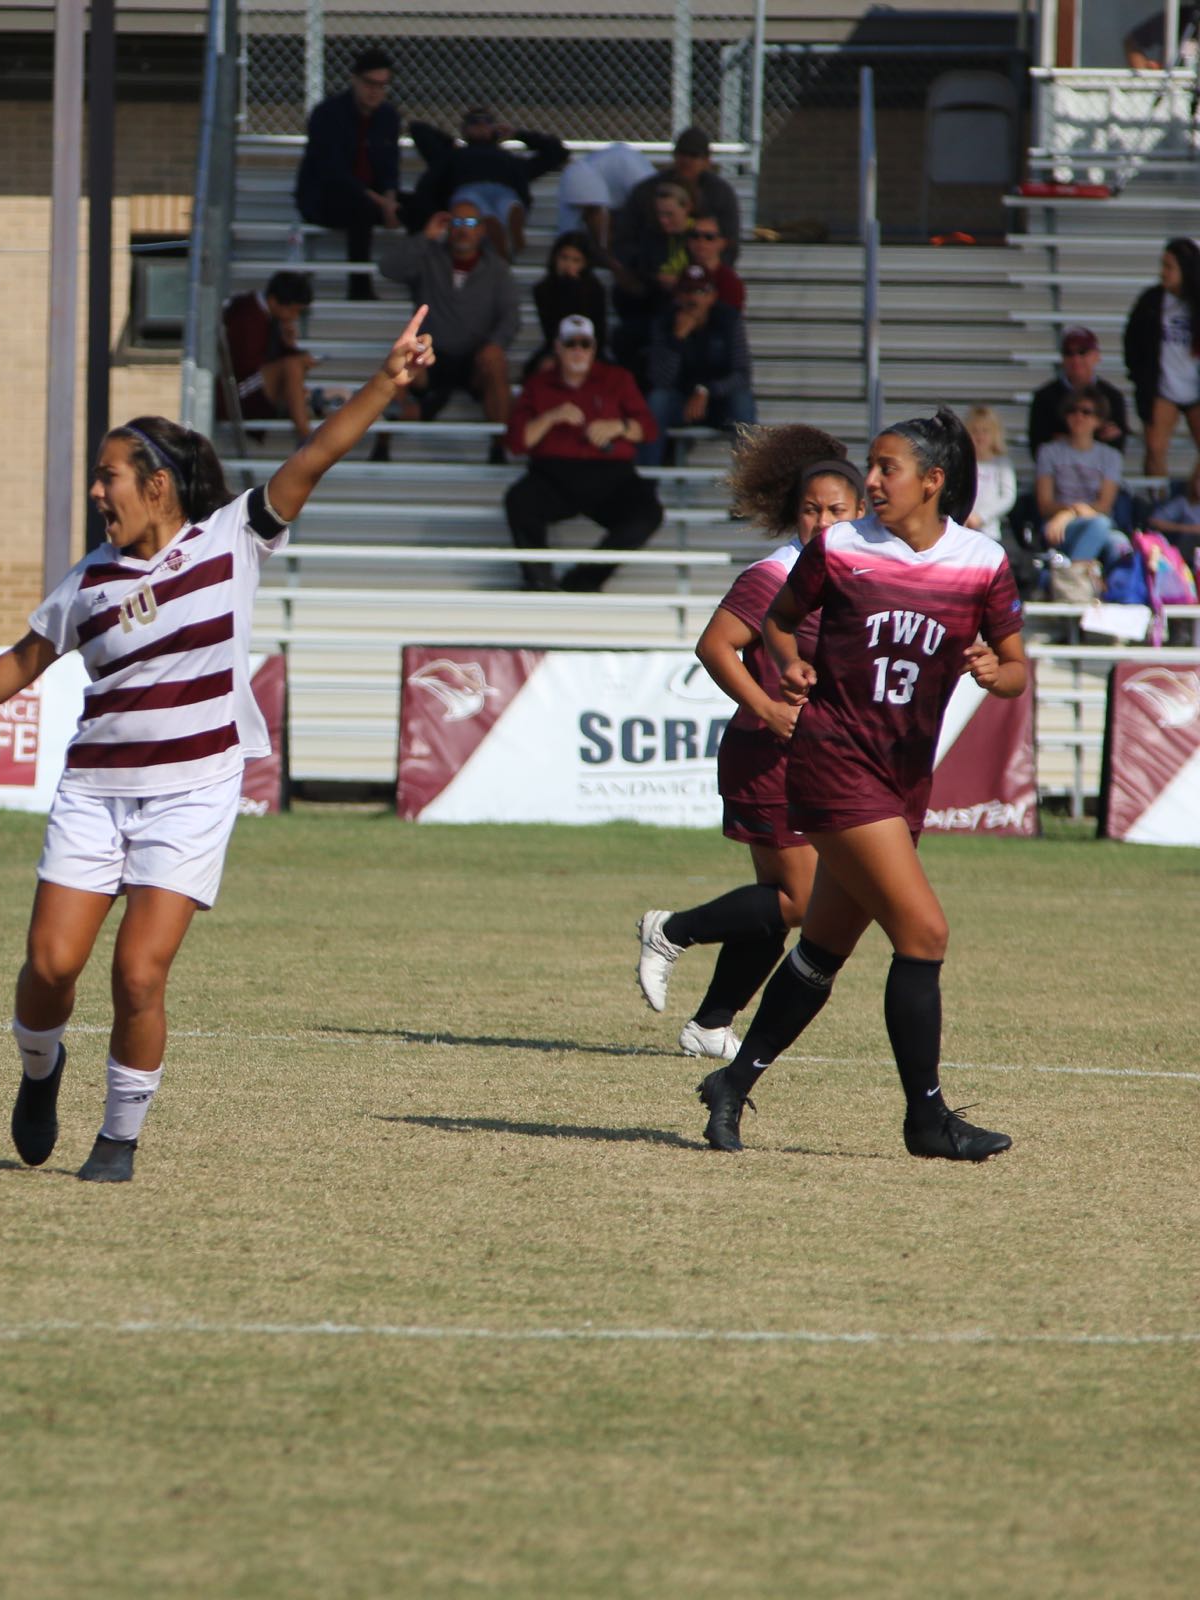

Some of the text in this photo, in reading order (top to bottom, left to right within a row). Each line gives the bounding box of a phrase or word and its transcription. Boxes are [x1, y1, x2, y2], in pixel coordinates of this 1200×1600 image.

[118, 582, 157, 634] 10
[865, 610, 946, 656] TWU
[872, 656, 920, 705] 13
